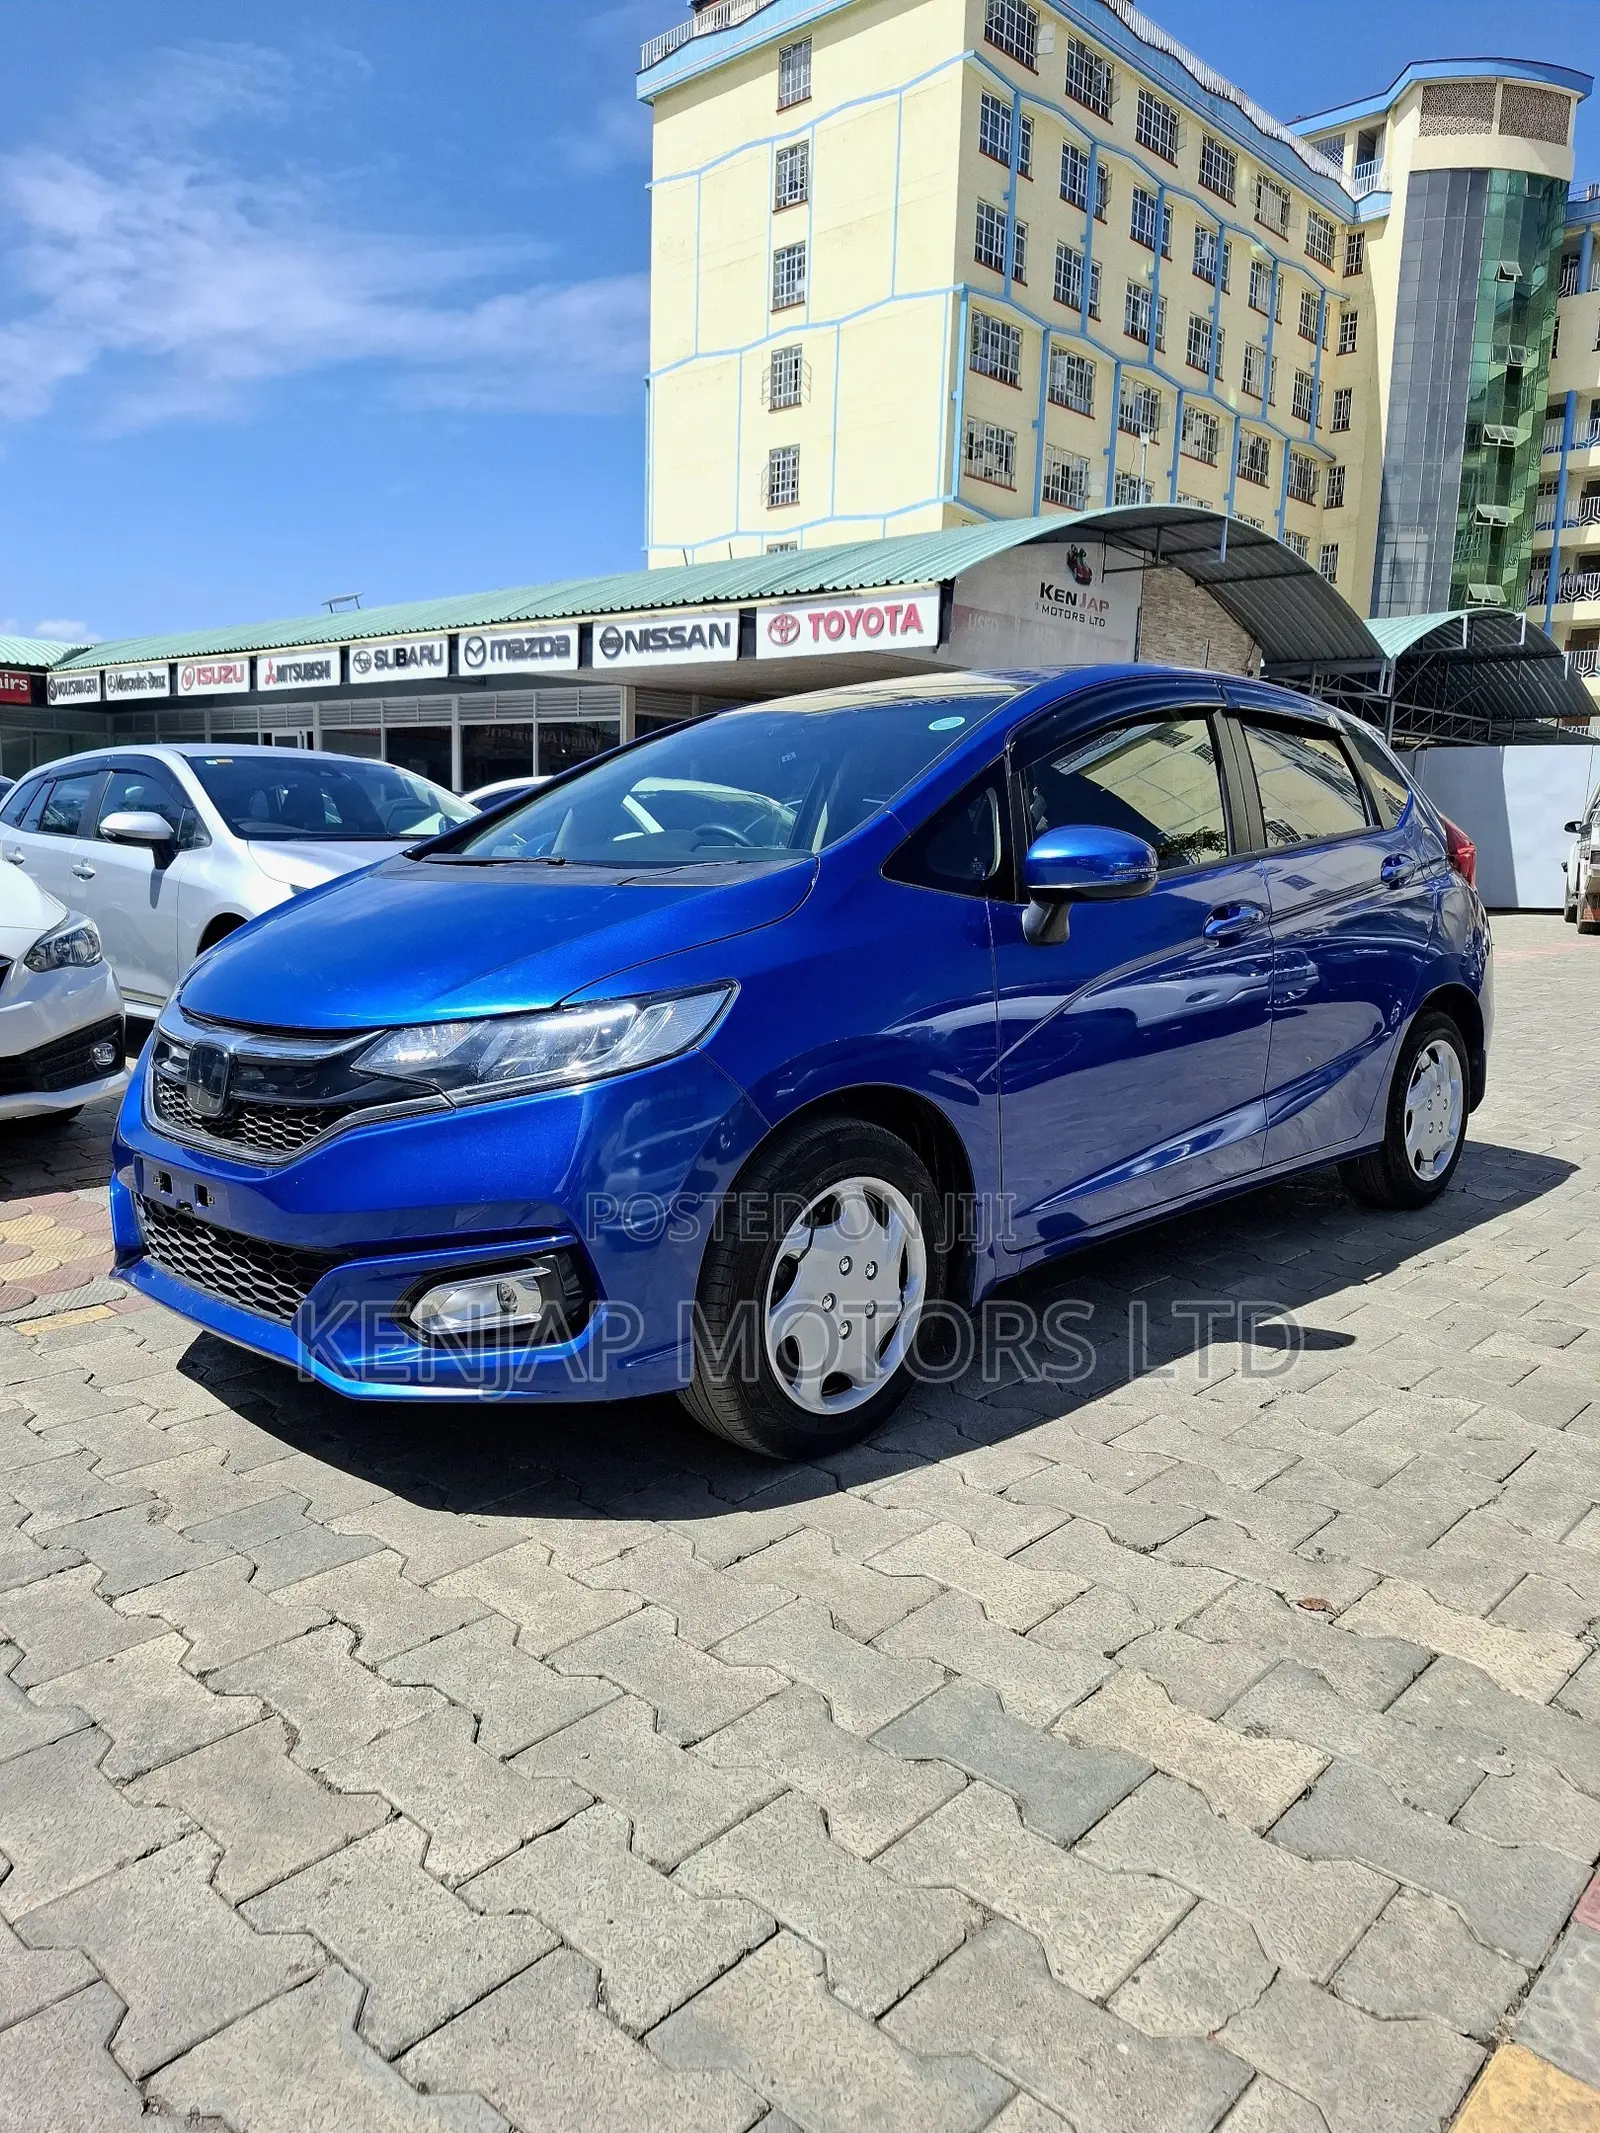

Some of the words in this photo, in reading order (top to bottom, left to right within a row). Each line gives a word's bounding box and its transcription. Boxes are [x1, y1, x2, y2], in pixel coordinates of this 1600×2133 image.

[1039, 582, 1110, 613] KENJAP
[808, 603, 924, 642] TOYOTA
[1041, 604, 1086, 623] MOTORS
[1088, 615, 1106, 628] LTD
[489, 634, 571, 663] mazda
[624, 621, 731, 654] NISSAN
[373, 642, 444, 670] SUBARU
[115, 671, 166, 692] Mercedes-Benz
[196, 664, 245, 686] ISUZU
[276, 660, 331, 684] MITSUBISHI
[57, 678, 97, 696] VOLKSWAGEN
